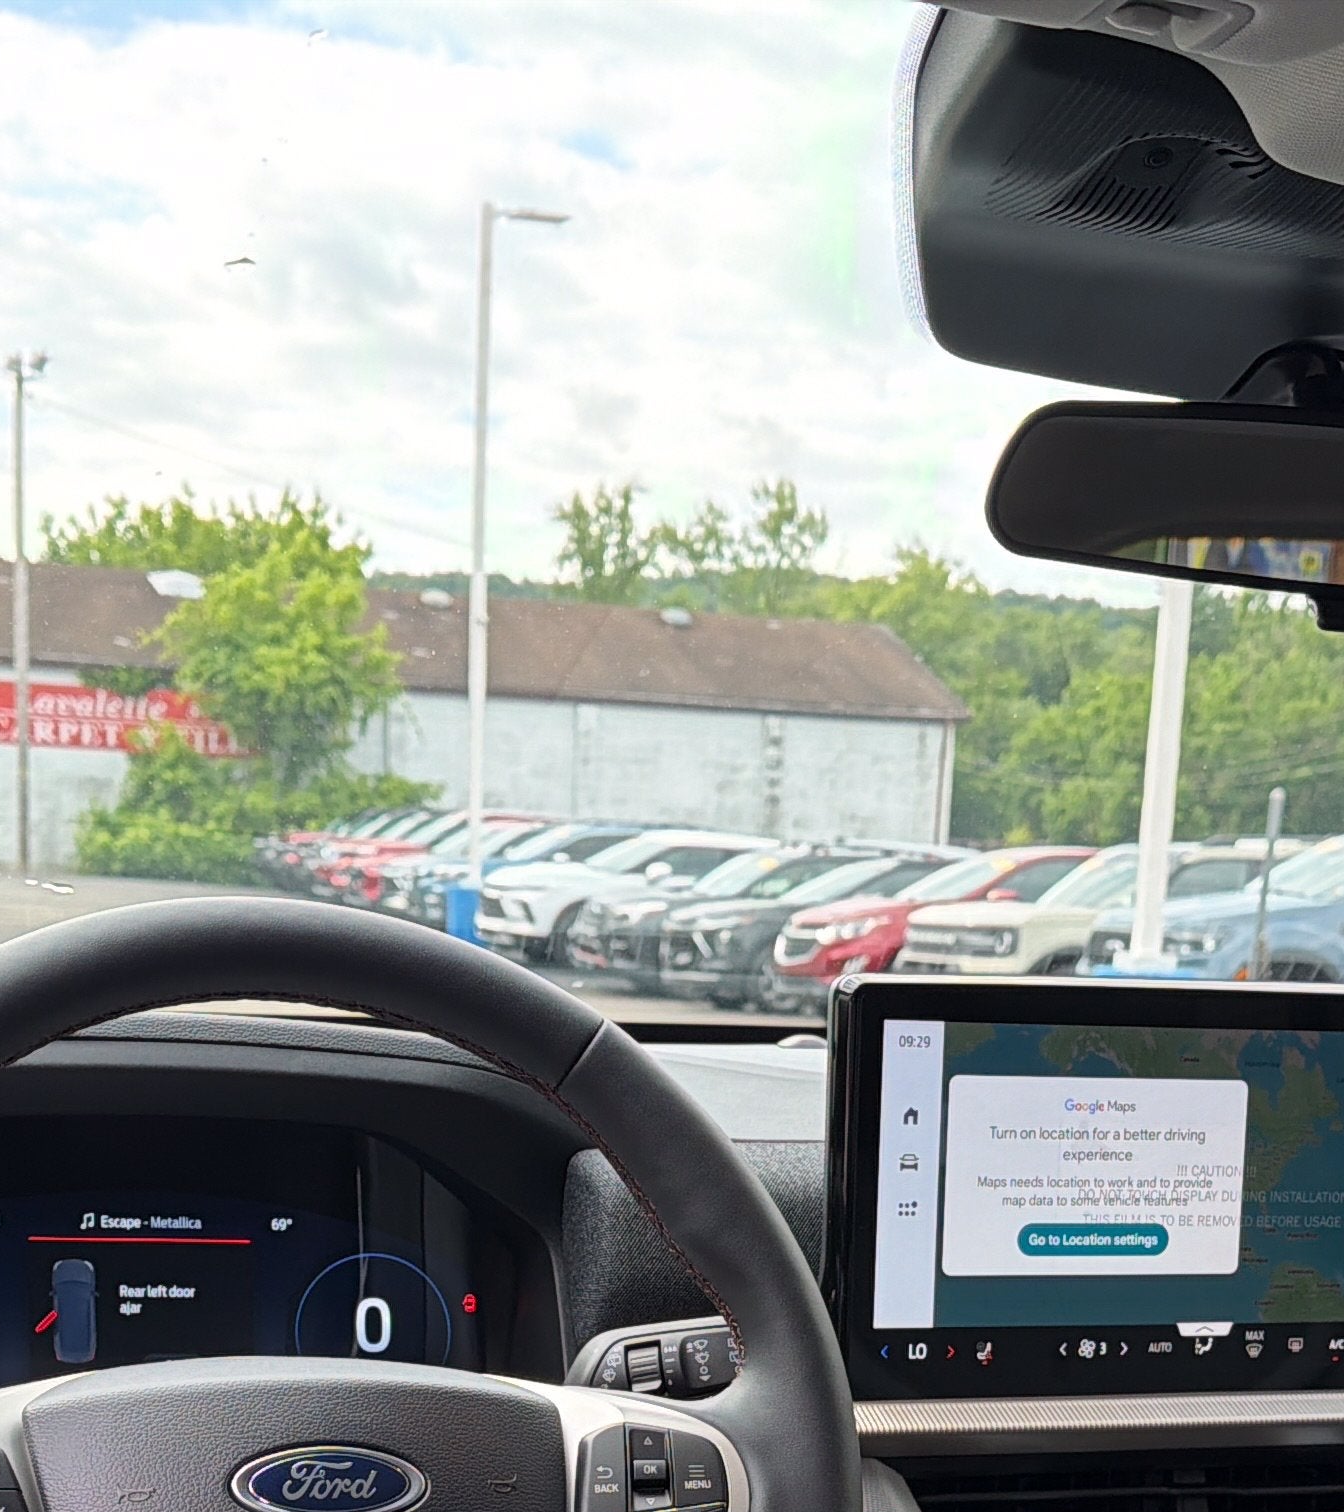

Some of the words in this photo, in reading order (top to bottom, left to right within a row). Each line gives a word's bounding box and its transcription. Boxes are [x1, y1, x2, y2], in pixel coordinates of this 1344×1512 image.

[898, 1035, 931, 1048] 09:29
[1064, 1098, 1105, 1114] Google
[1107, 1101, 1136, 1115] Maps
[990, 1126, 1017, 1140] Turn
[1020, 1129, 1036, 1140] on
[1039, 1127, 1089, 1141] location
[1092, 1127, 1109, 1141] for
[1113, 1130, 1121, 1141] a
[1123, 1128, 1161, 1141] better
[1164, 1128, 1206, 1145] driving
[1063, 1148, 1133, 1163] experience
[1191, 1165, 1241, 1178] CAUTION
[977, 1176, 1007, 1190] Maps
[1010, 1176, 1044, 1188] needs
[1047, 1176, 1090, 1188] location
[1094, 1177, 1104, 1188] to
[1108, 1176, 1134, 1188] work
[1137, 1177, 1156, 1189] and
[1160, 1178, 1170, 1189] to
[1173, 1176, 1213, 1191] provide
[1002, 1197, 1026, 1208] map
[1029, 1194, 1053, 1206] data
[1057, 1195, 1067, 1206] to
[1071, 1197, 1100, 1206] some
[1104, 1194, 1140, 1206] vehicle
[1144, 1194, 1188, 1206] features
[1171, 1190, 1218, 1201] DISPLAY
[100, 1215, 141, 1230] Escape
[150, 1216, 202, 1230] Metallica
[271, 1218, 293, 1231] 69°
[1160, 1215, 1174, 1226] TO
[1179, 1215, 1194, 1226] BE
[1257, 1216, 1300, 1227] BEFORE
[1306, 1216, 1342, 1228] USAGE
[1029, 1233, 1045, 1246] Go
[1049, 1234, 1060, 1246] to
[1063, 1234, 1111, 1246] Location
[1113, 1234, 1158, 1249] settings
[119, 1285, 145, 1298] Rear
[147, 1285, 168, 1298] left
[169, 1286, 196, 1298] door
[119, 1302, 142, 1315] ajar
[355, 1297, 391, 1353] 0
[1245, 1330, 1265, 1341] MAX
[908, 1343, 927, 1360] LO
[1099, 1343, 1107, 1355] 3
[1148, 1342, 1172, 1353] AUTO
[643, 1465, 657, 1475] OK
[282, 1460, 378, 1501] Ford
[684, 1480, 712, 1490] MENU
[594, 1484, 619, 1494] BACK
